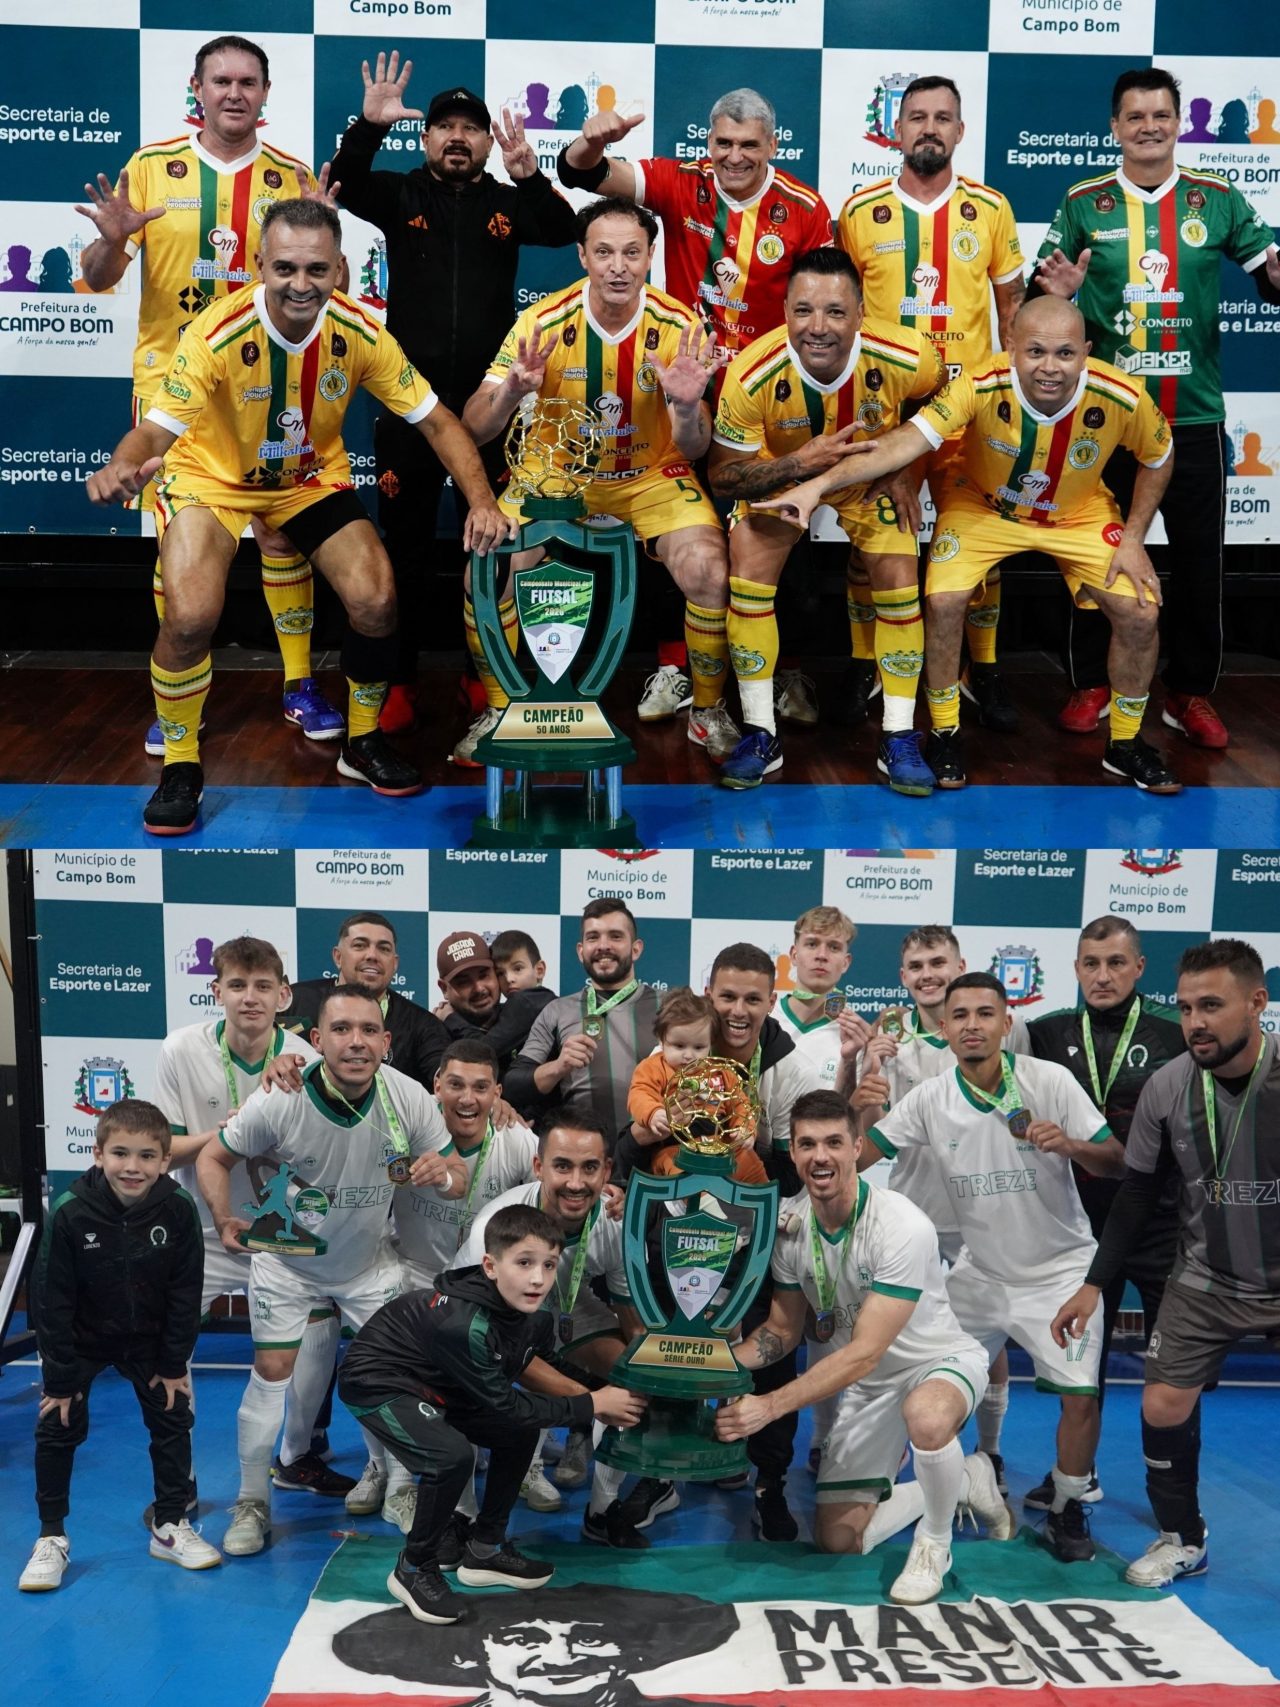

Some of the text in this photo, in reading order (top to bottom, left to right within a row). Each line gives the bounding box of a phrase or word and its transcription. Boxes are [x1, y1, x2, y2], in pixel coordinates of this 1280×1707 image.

[350, 0, 452, 18] Campo Bom
[1022, 17, 1120, 34] Campo Bom
[0, 105, 110, 124] Secretaria de
[0, 126, 122, 146] sporte e Lazer
[1019, 130, 1098, 147] Secretaria
[1007, 149, 1124, 168] Esporte e Laze
[1199, 152, 1270, 164] Prefeitura de
[20, 301, 97, 314] Prefeitura de
[70, 318, 114, 334] BOM
[1139, 317, 1193, 328] CONCEITO
[922, 331, 965, 342] ONCEITO
[2, 447, 111, 463] Secretaria de
[1, 467, 72, 485] sporte e
[674, 478, 702, 502] 5
[1243, 484, 1256, 494] de
[876, 495, 899, 525] 8
[1230, 499, 1270, 513] BOM
[531, 589, 578, 604] FUTSAL
[523, 707, 584, 723] CAMPEÃO
[536, 724, 571, 735] 50 ANOS
[55, 852, 136, 868] Município de
[333, 849, 392, 860] Prefeitura de
[446, 849, 548, 865] Esporte e Lazer
[984, 849, 1067, 863] Secretaria de
[371, 863, 404, 876] BOM
[711, 855, 813, 871] Esporte e Lazer
[864, 865, 921, 875] Prefeitura de
[56, 870, 136, 885] Campo Bom
[587, 869, 668, 886] Município de
[974, 864, 1075, 880] Esporte e Lazer
[900, 878, 933, 891] BOM
[1109, 883, 1188, 899] Município de
[638, 888, 667, 901] Bom
[1109, 900, 1186, 915] Campo Bom
[57, 963, 142, 978] Secretaria de
[49, 978, 151, 994] Esporte e Lazer
[845, 984, 909, 998] Secretaria
[845, 1000, 886, 1012] sporte
[950, 1168, 1037, 1199] TREZE
[677, 1235, 721, 1252] FUTSAL
[658, 1340, 714, 1356] CAMPEÃO
[686, 1356, 706, 1365] OURO
[764, 1600, 1145, 1652] MANIR
[779, 1646, 1182, 1684] PRESENTE
